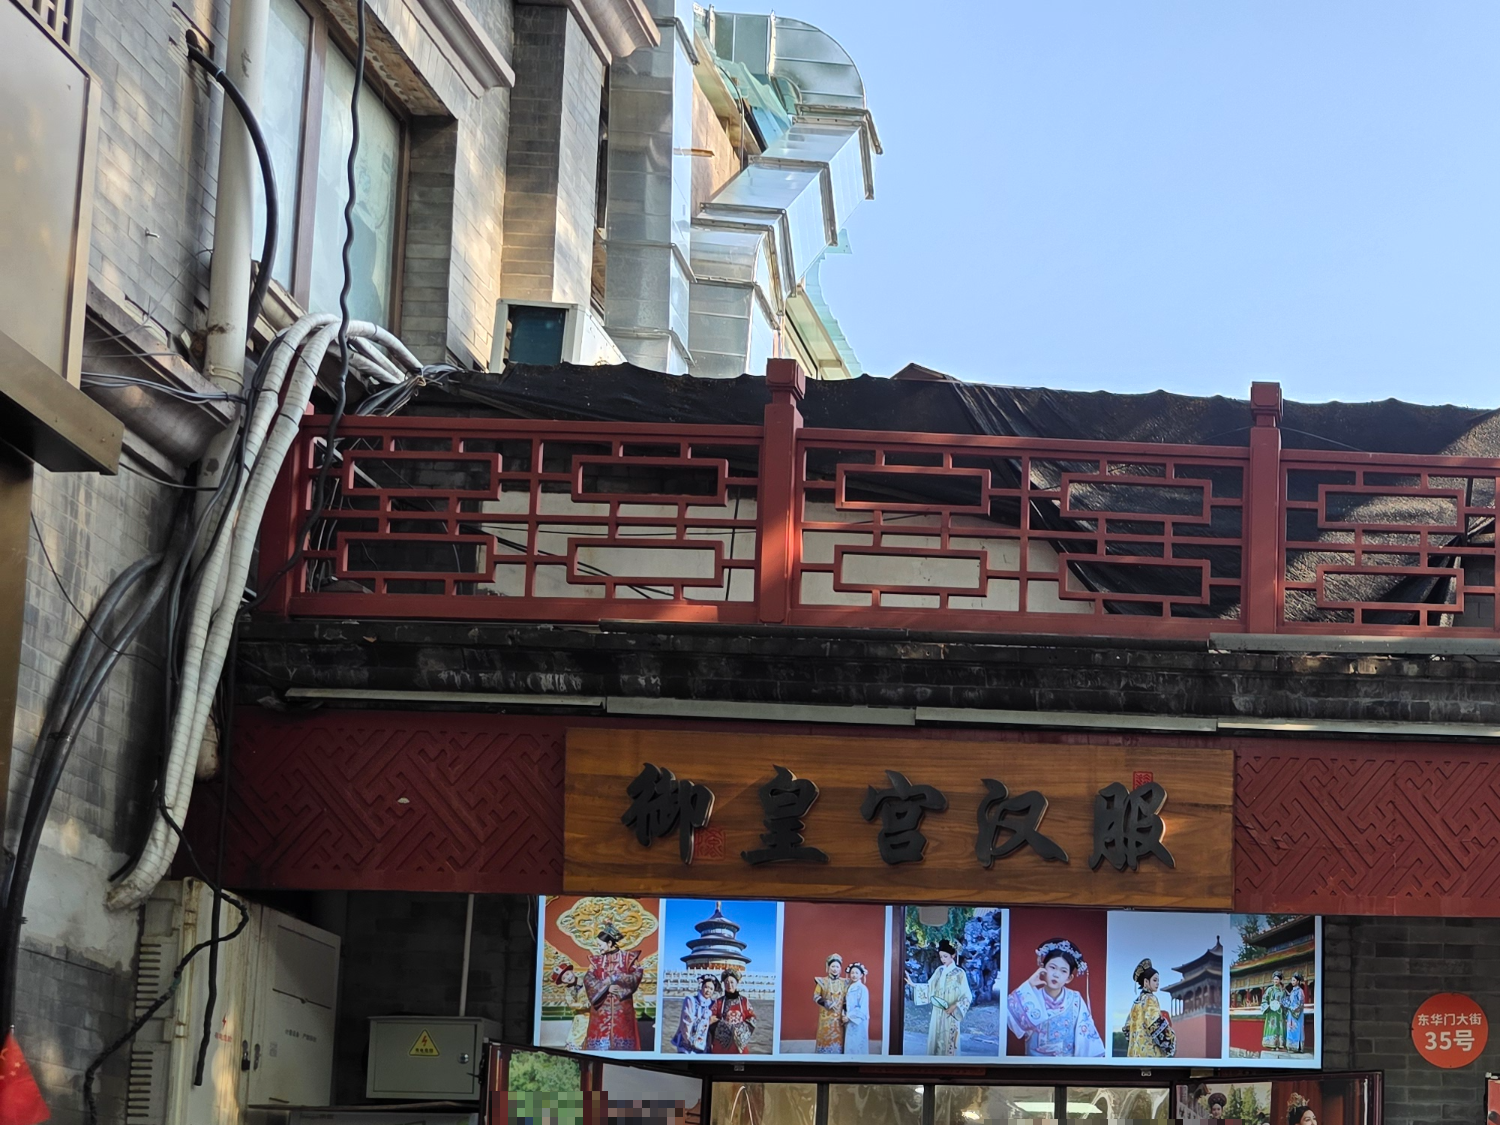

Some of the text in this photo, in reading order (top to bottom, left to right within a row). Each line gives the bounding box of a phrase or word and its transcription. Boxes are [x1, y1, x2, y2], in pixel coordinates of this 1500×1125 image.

[621, 762, 1176, 872] 御皇宫汉服
[1417, 1013, 1482, 1026] 东华门大街
[1424, 1029, 1475, 1052] 35号
